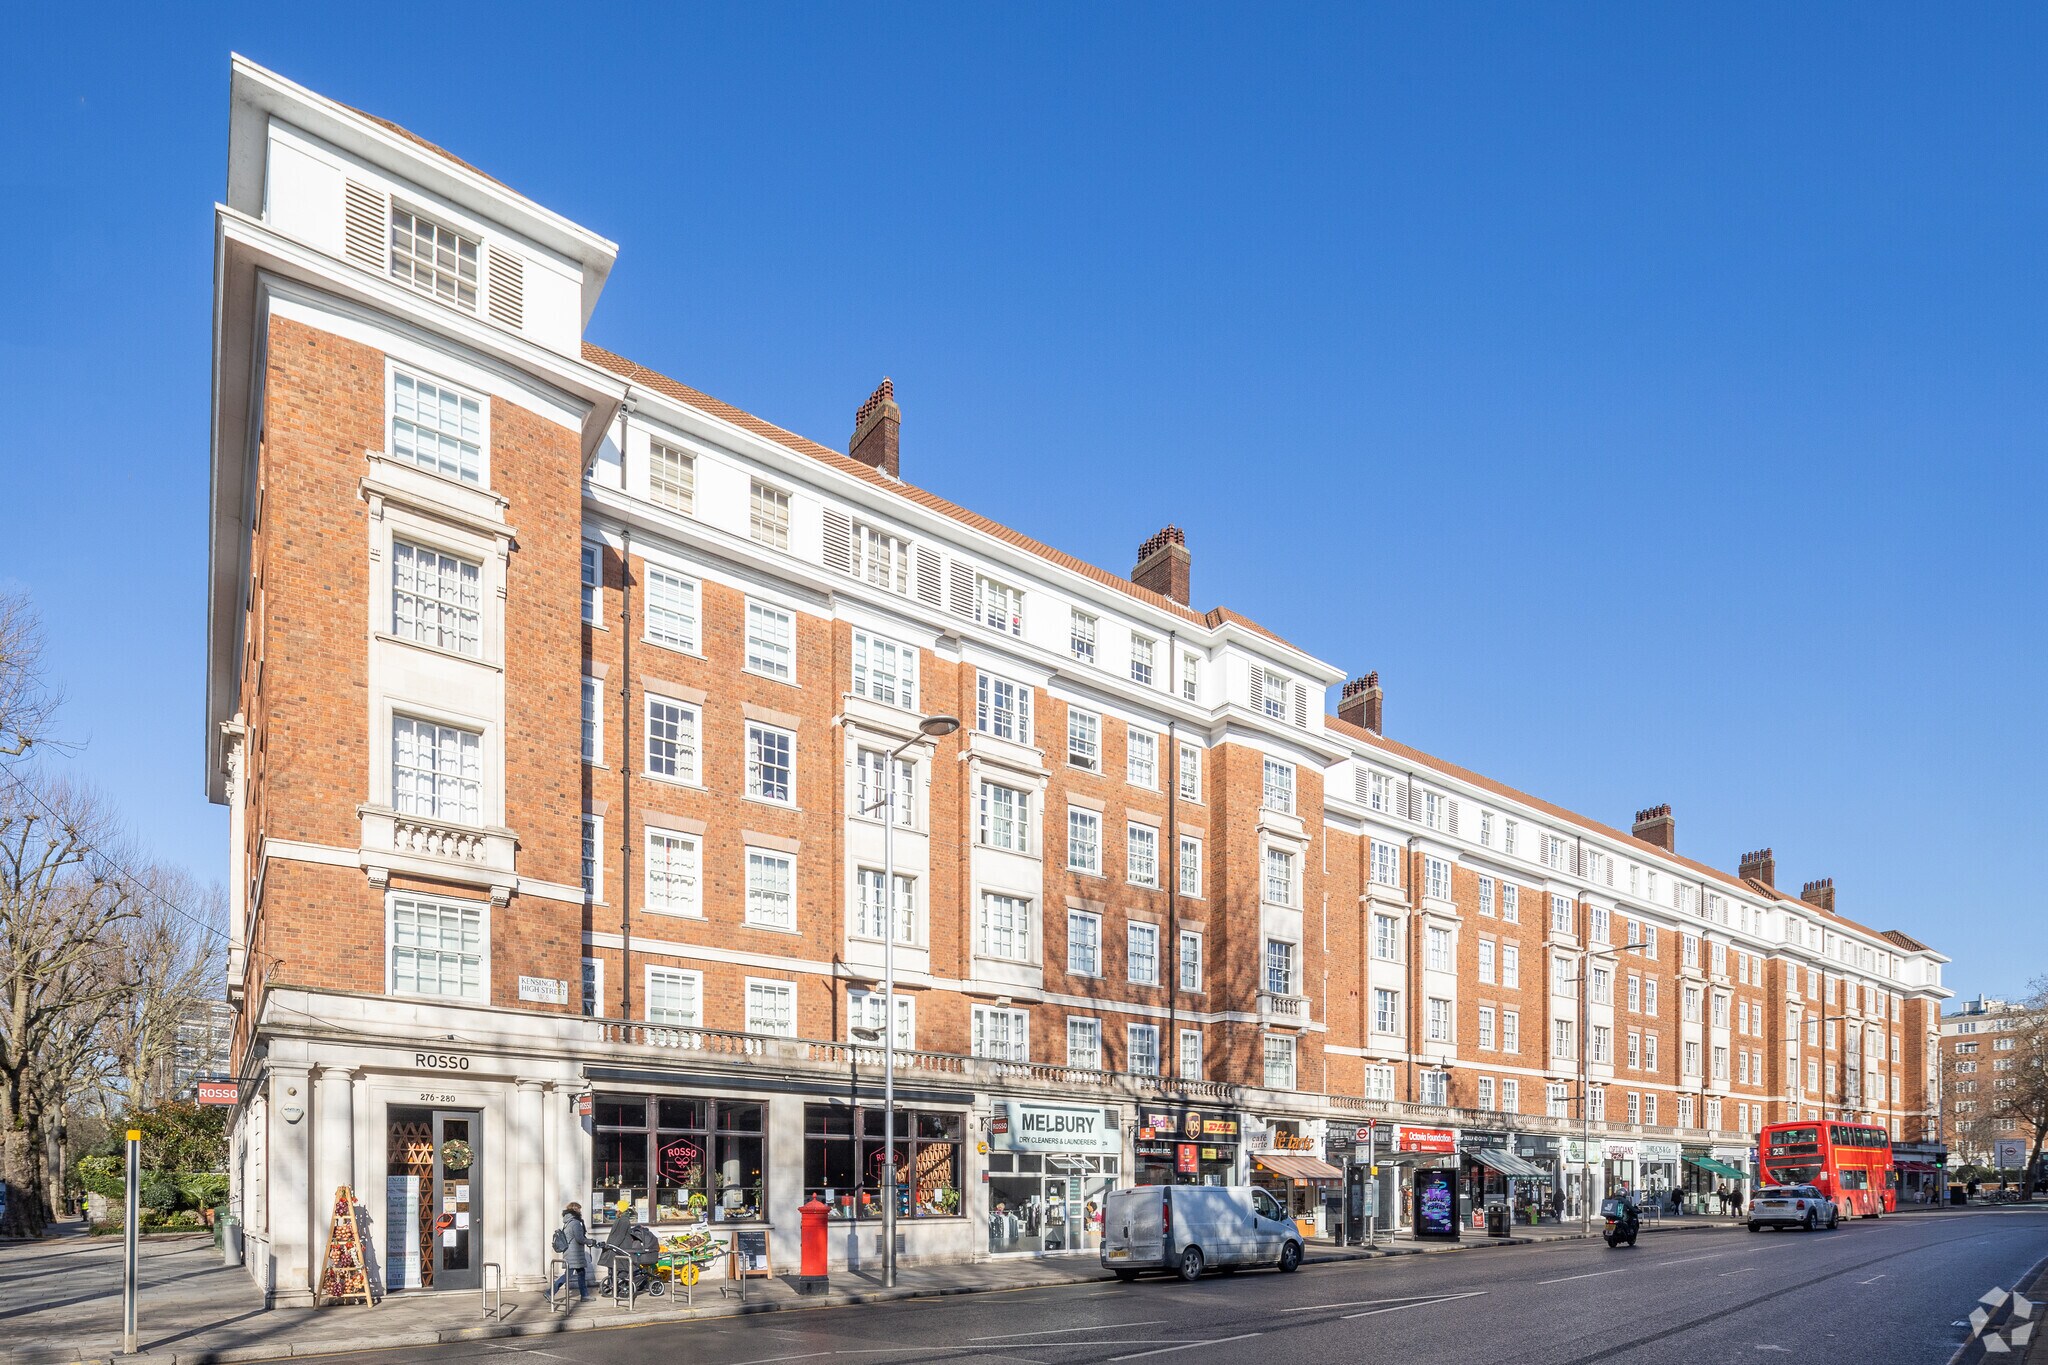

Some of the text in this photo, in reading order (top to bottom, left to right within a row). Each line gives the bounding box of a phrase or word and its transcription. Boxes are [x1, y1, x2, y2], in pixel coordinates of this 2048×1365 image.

[521, 978, 566, 988] KENSINGTON
[521, 985, 566, 995] HIGH STREET
[415, 1053, 469, 1070] ROSSO
[199, 1088, 238, 1098] ROSSO
[992, 1122, 1008, 1130] ROSSO
[1022, 1113, 1095, 1133] MELBURY
[1151, 1115, 1176, 1128] FedEx
[1187, 1121, 1200, 1135] ups
[1208, 1123, 1233, 1132] DHL
[1031, 1137, 1059, 1145] CLEANERS
[1408, 1131, 1426, 1141] Octavia
[1427, 1133, 1452, 1142] Foundation
[1288, 1134, 1315, 1151] tarte
[667, 1147, 697, 1158] ROSSO
[1772, 1147, 1784, 1156] 23
[876, 1153, 898, 1162] ROO
